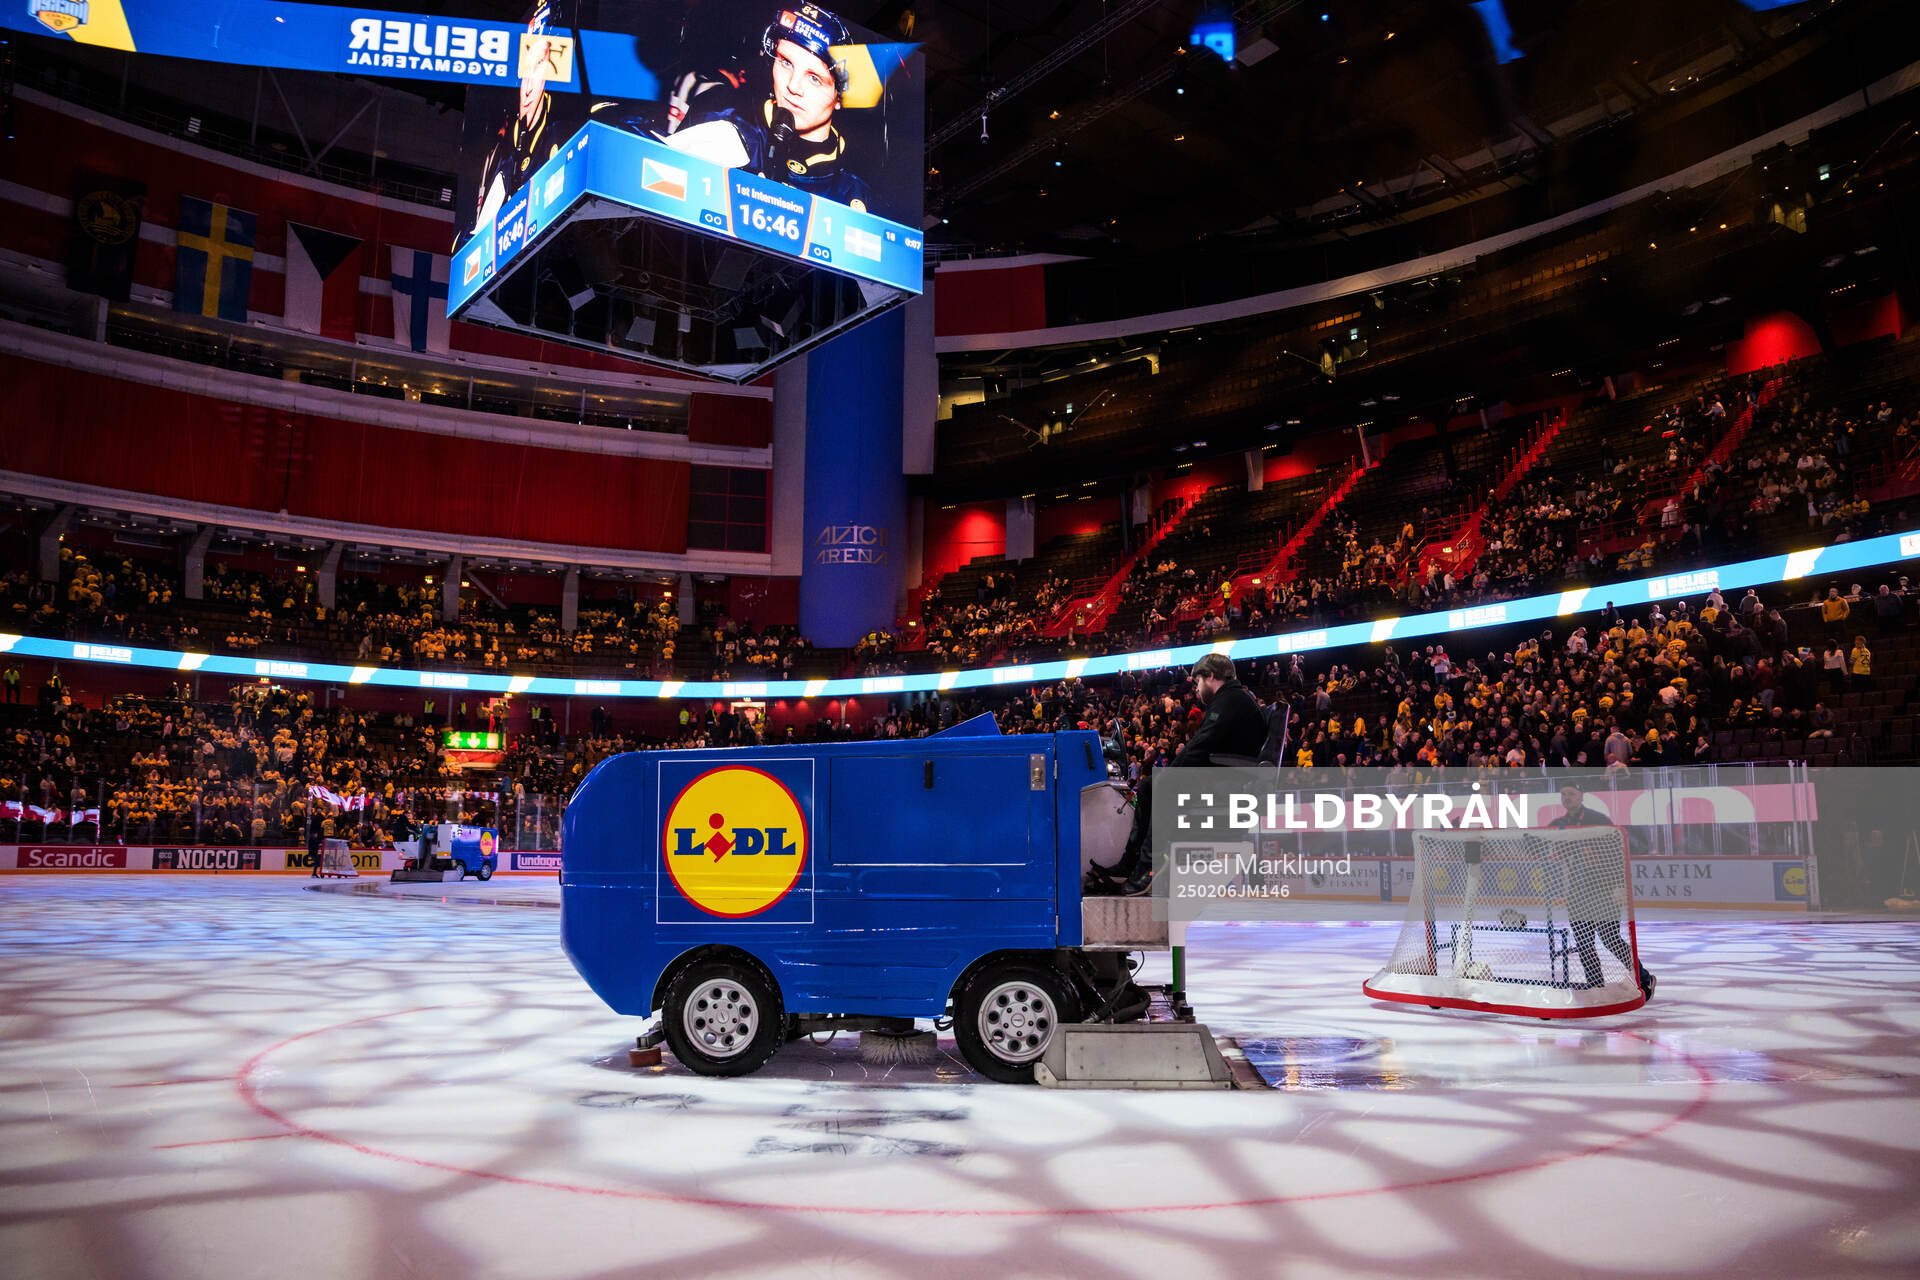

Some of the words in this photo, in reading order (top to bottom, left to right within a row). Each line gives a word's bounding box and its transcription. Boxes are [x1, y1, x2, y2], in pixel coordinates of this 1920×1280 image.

[702, 177, 711, 196] 1
[735, 183, 750, 197] 1st
[751, 188, 804, 215] Intermission
[739, 204, 800, 240] 16:46
[823, 216, 832, 236] 1
[497, 216, 524, 256] 16:46
[814, 548, 889, 565] ARENA
[29, 849, 115, 867] Scandic
[177, 849, 239, 869] NOCCO
[1635, 863, 1713, 879] RAFIM
[1330, 878, 1369, 888] FINANS
[1634, 885, 1692, 897] NANS
